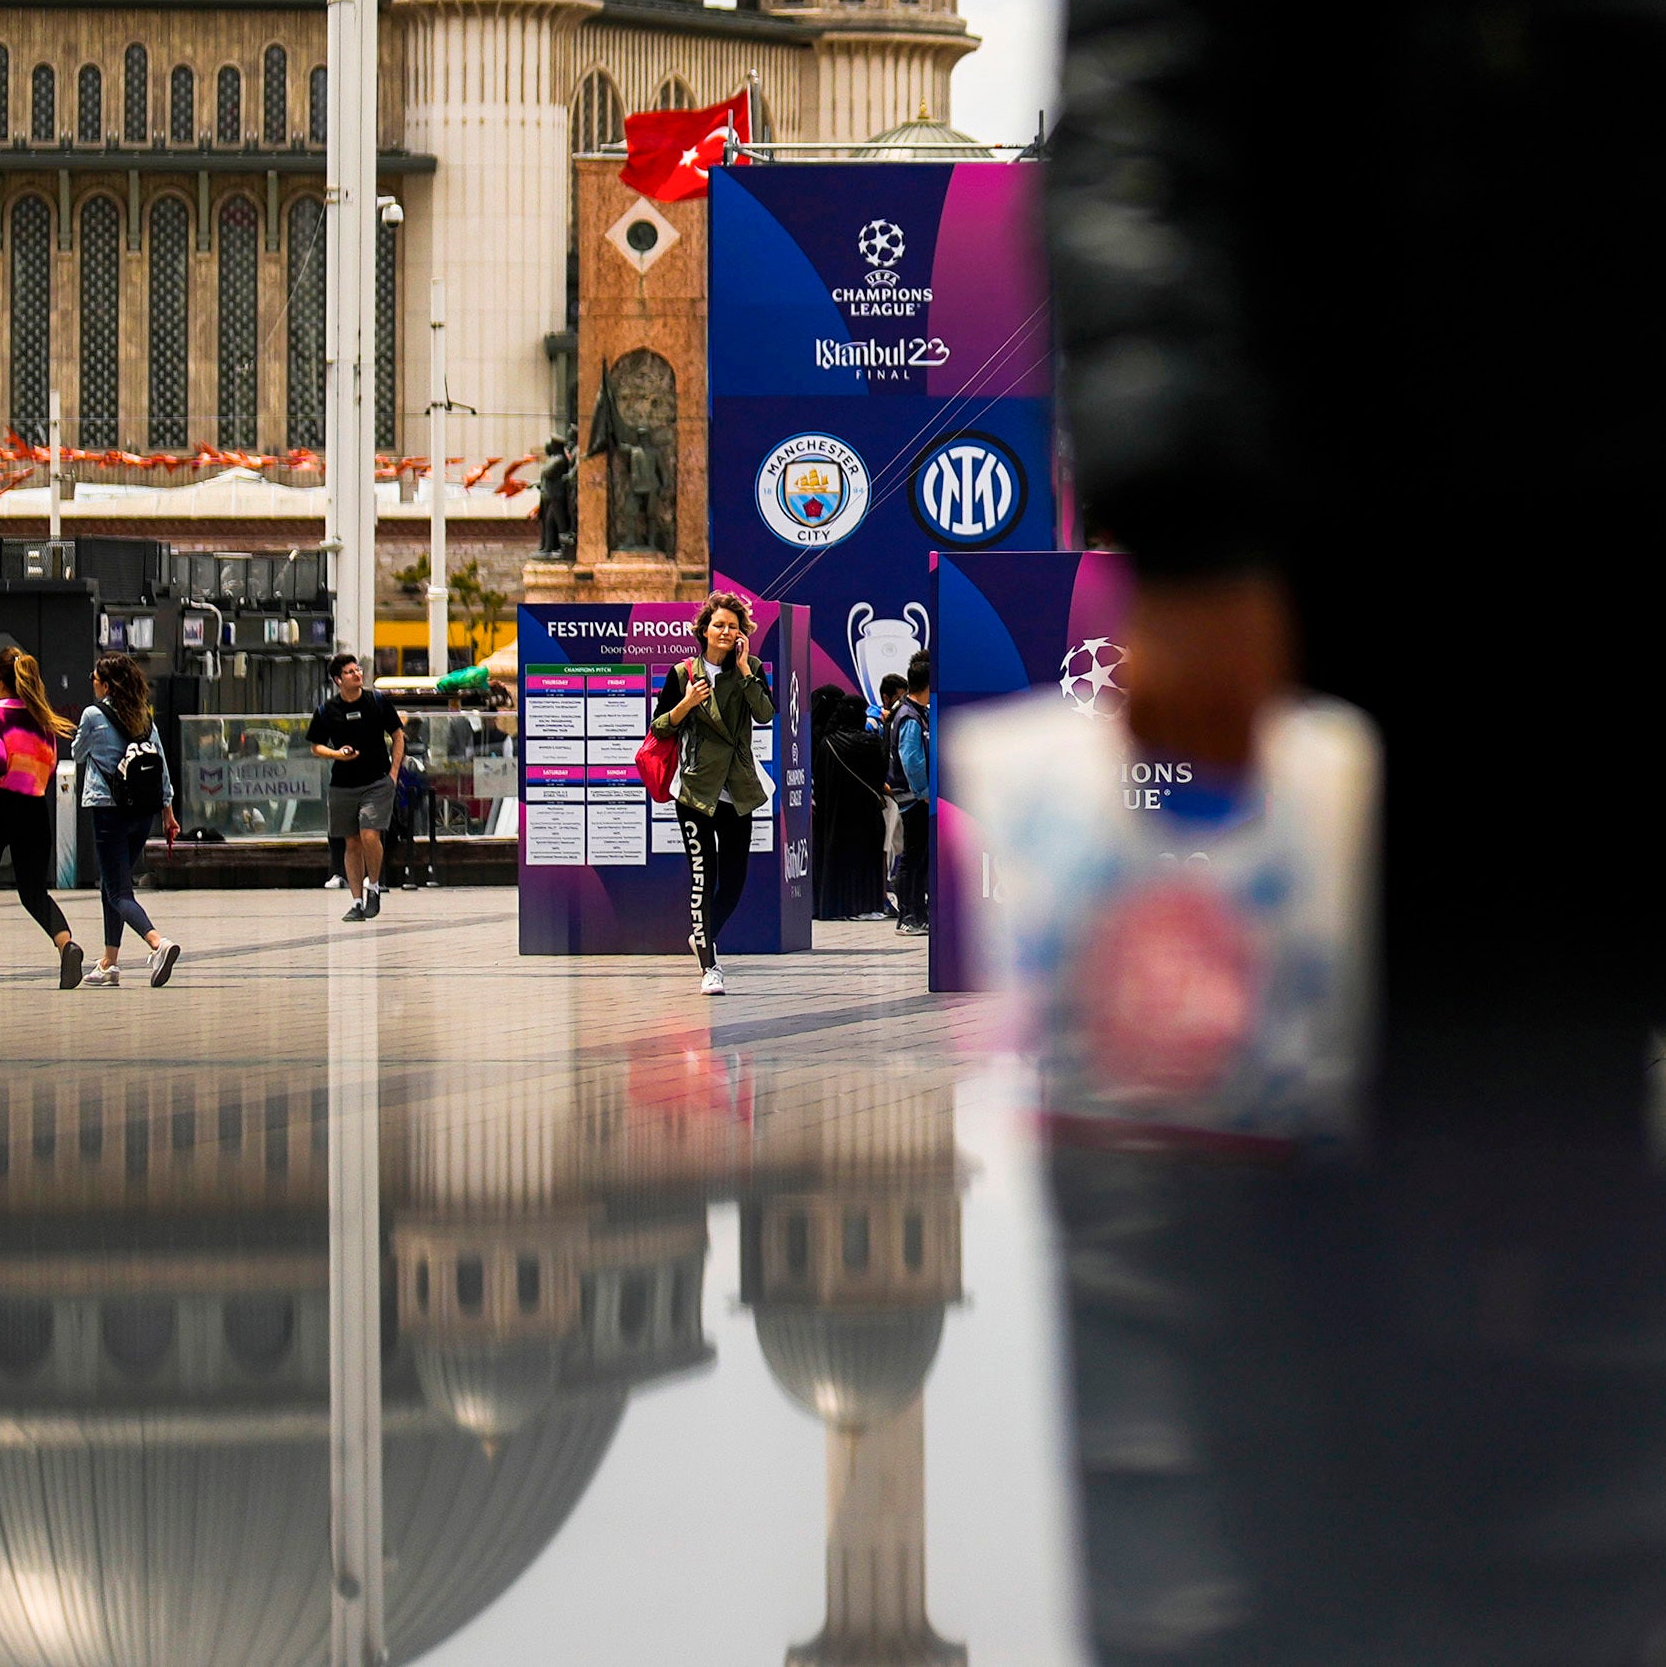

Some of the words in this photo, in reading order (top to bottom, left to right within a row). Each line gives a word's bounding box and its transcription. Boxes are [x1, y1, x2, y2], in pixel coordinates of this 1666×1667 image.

[866, 272, 897, 286] UEFA
[832, 288, 933, 302] CHAMPIONS
[850, 303, 916, 316] LEAGUE
[855, 369, 911, 380] FINAL
[766, 439, 859, 476] MANCHESTER
[797, 530, 831, 541] CITY
[547, 621, 628, 637] FESTIVAL
[633, 621, 696, 638] PROGR
[600, 644, 627, 655] Doors
[628, 645, 654, 657] Open:
[656, 644, 697, 655] 11:00am
[684, 820, 707, 949] CONFIDENT
